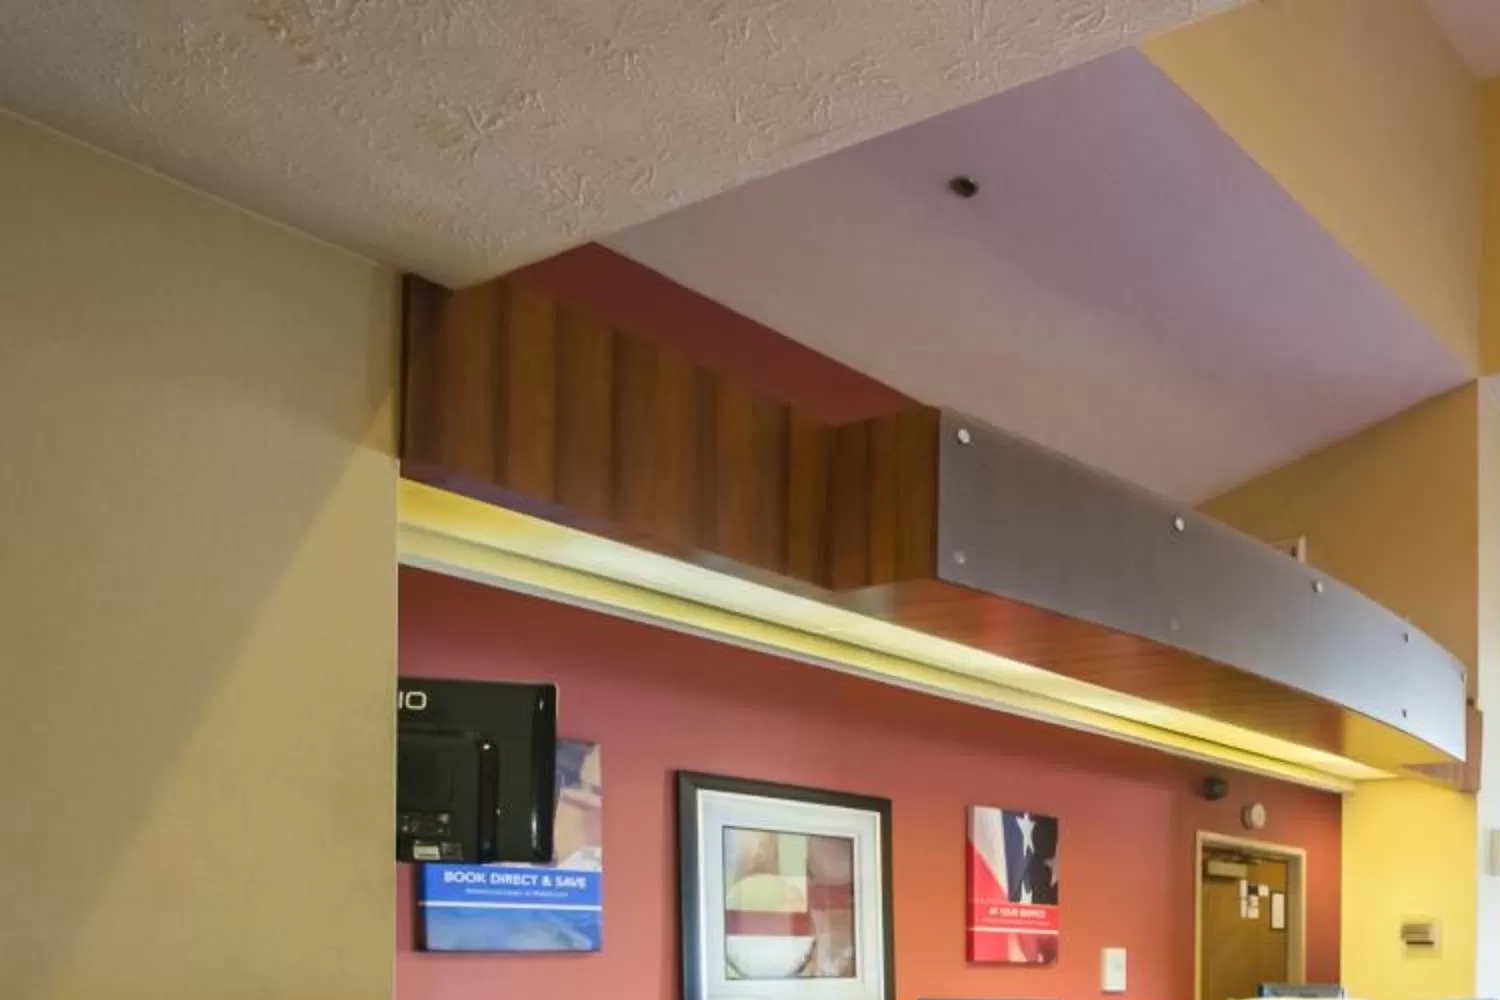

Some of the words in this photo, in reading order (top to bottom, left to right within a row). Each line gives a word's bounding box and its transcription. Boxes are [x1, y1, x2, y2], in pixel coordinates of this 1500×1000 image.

[443, 870, 486, 884] BOOK
[490, 872, 538, 886] DIRECT
[541, 874, 552, 887] &
[555, 875, 587, 889] SAVE
